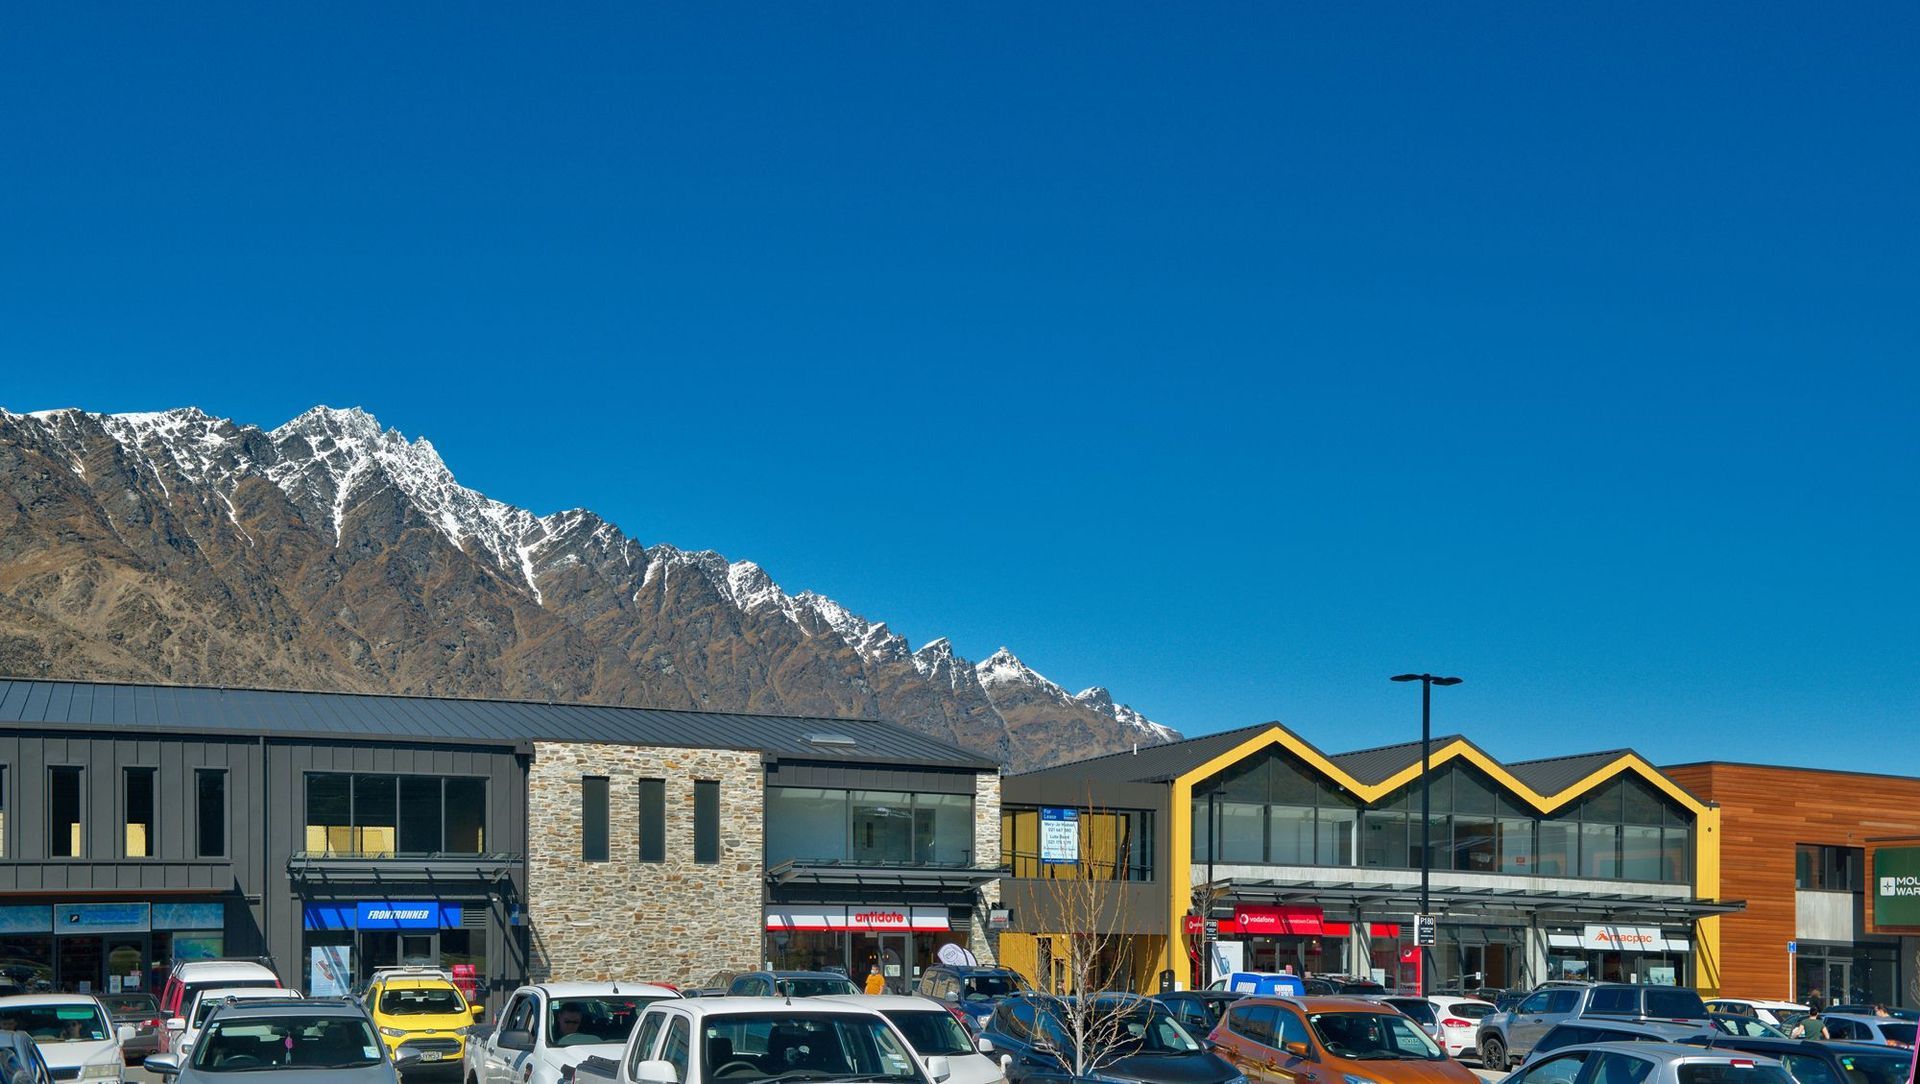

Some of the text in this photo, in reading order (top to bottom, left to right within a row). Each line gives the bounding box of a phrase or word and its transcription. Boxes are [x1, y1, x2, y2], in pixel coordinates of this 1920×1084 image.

[367, 910, 430, 919] FRONTRUNNER
[855, 911, 904, 923] antidote
[1420, 917, 1434, 926] P180
[1610, 933, 1653, 944] macpac
